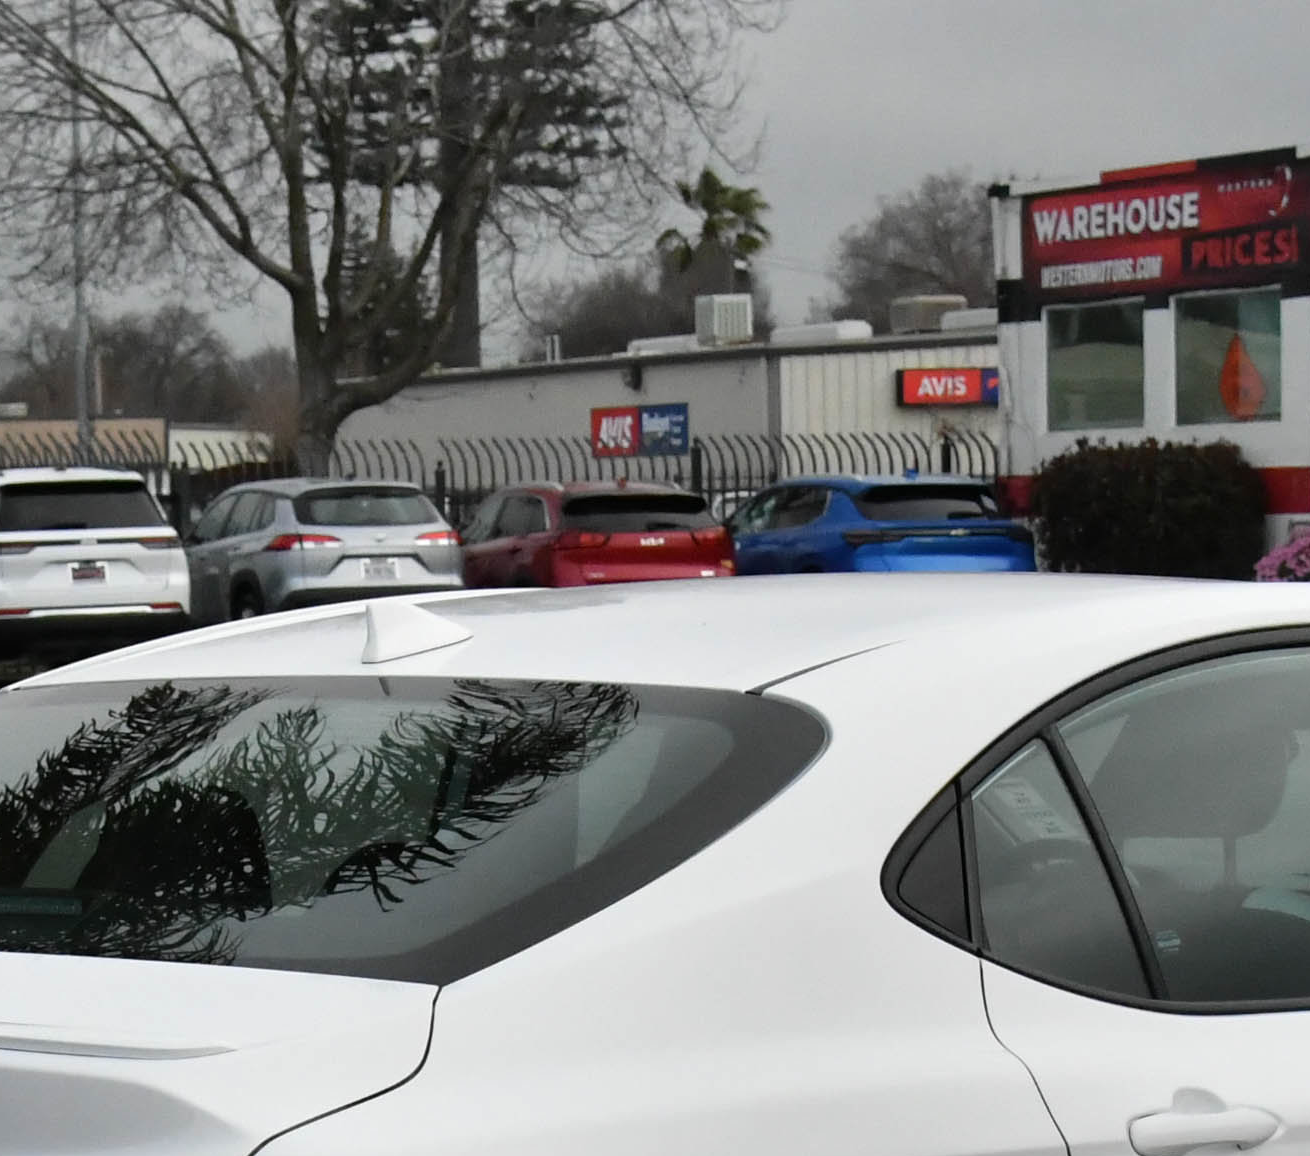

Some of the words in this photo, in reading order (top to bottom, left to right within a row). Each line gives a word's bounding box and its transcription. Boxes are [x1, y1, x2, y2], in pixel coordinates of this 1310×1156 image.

[1033, 191, 1200, 246] WAREHOUSE
[1191, 224, 1299, 269] PRICES!
[917, 376, 967, 397] AVIS
[598, 415, 633, 448] AVIS
